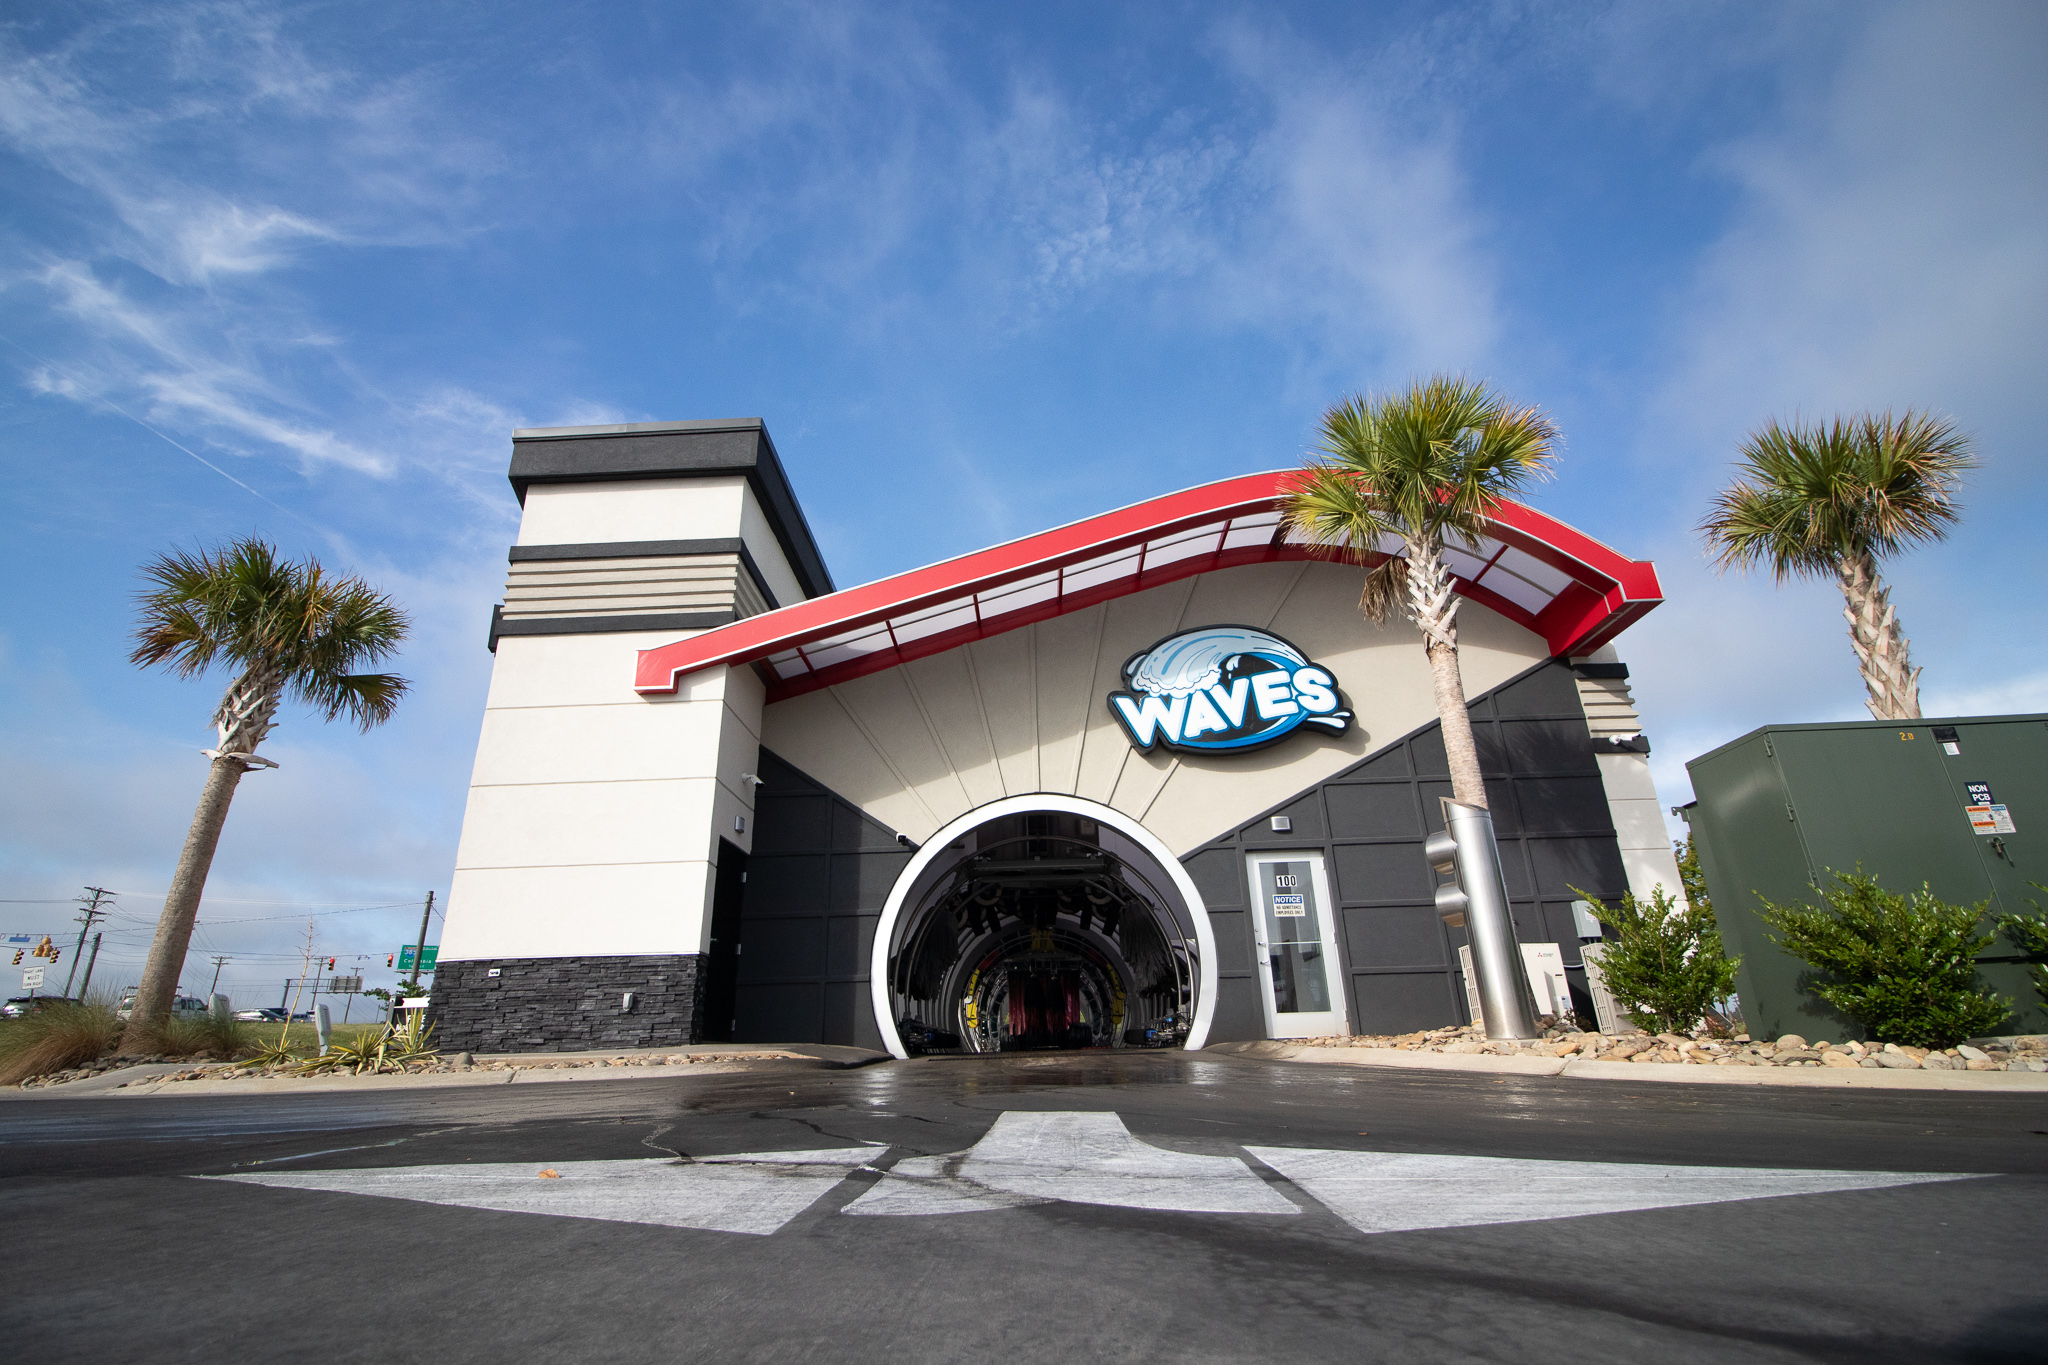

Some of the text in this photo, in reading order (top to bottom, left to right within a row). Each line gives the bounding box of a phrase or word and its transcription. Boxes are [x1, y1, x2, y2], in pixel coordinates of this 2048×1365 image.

[1114, 667, 1338, 746] WAVES
[1967, 784, 1988, 793] NON
[1972, 793, 1991, 801] PCB
[1278, 875, 1296, 887] 100
